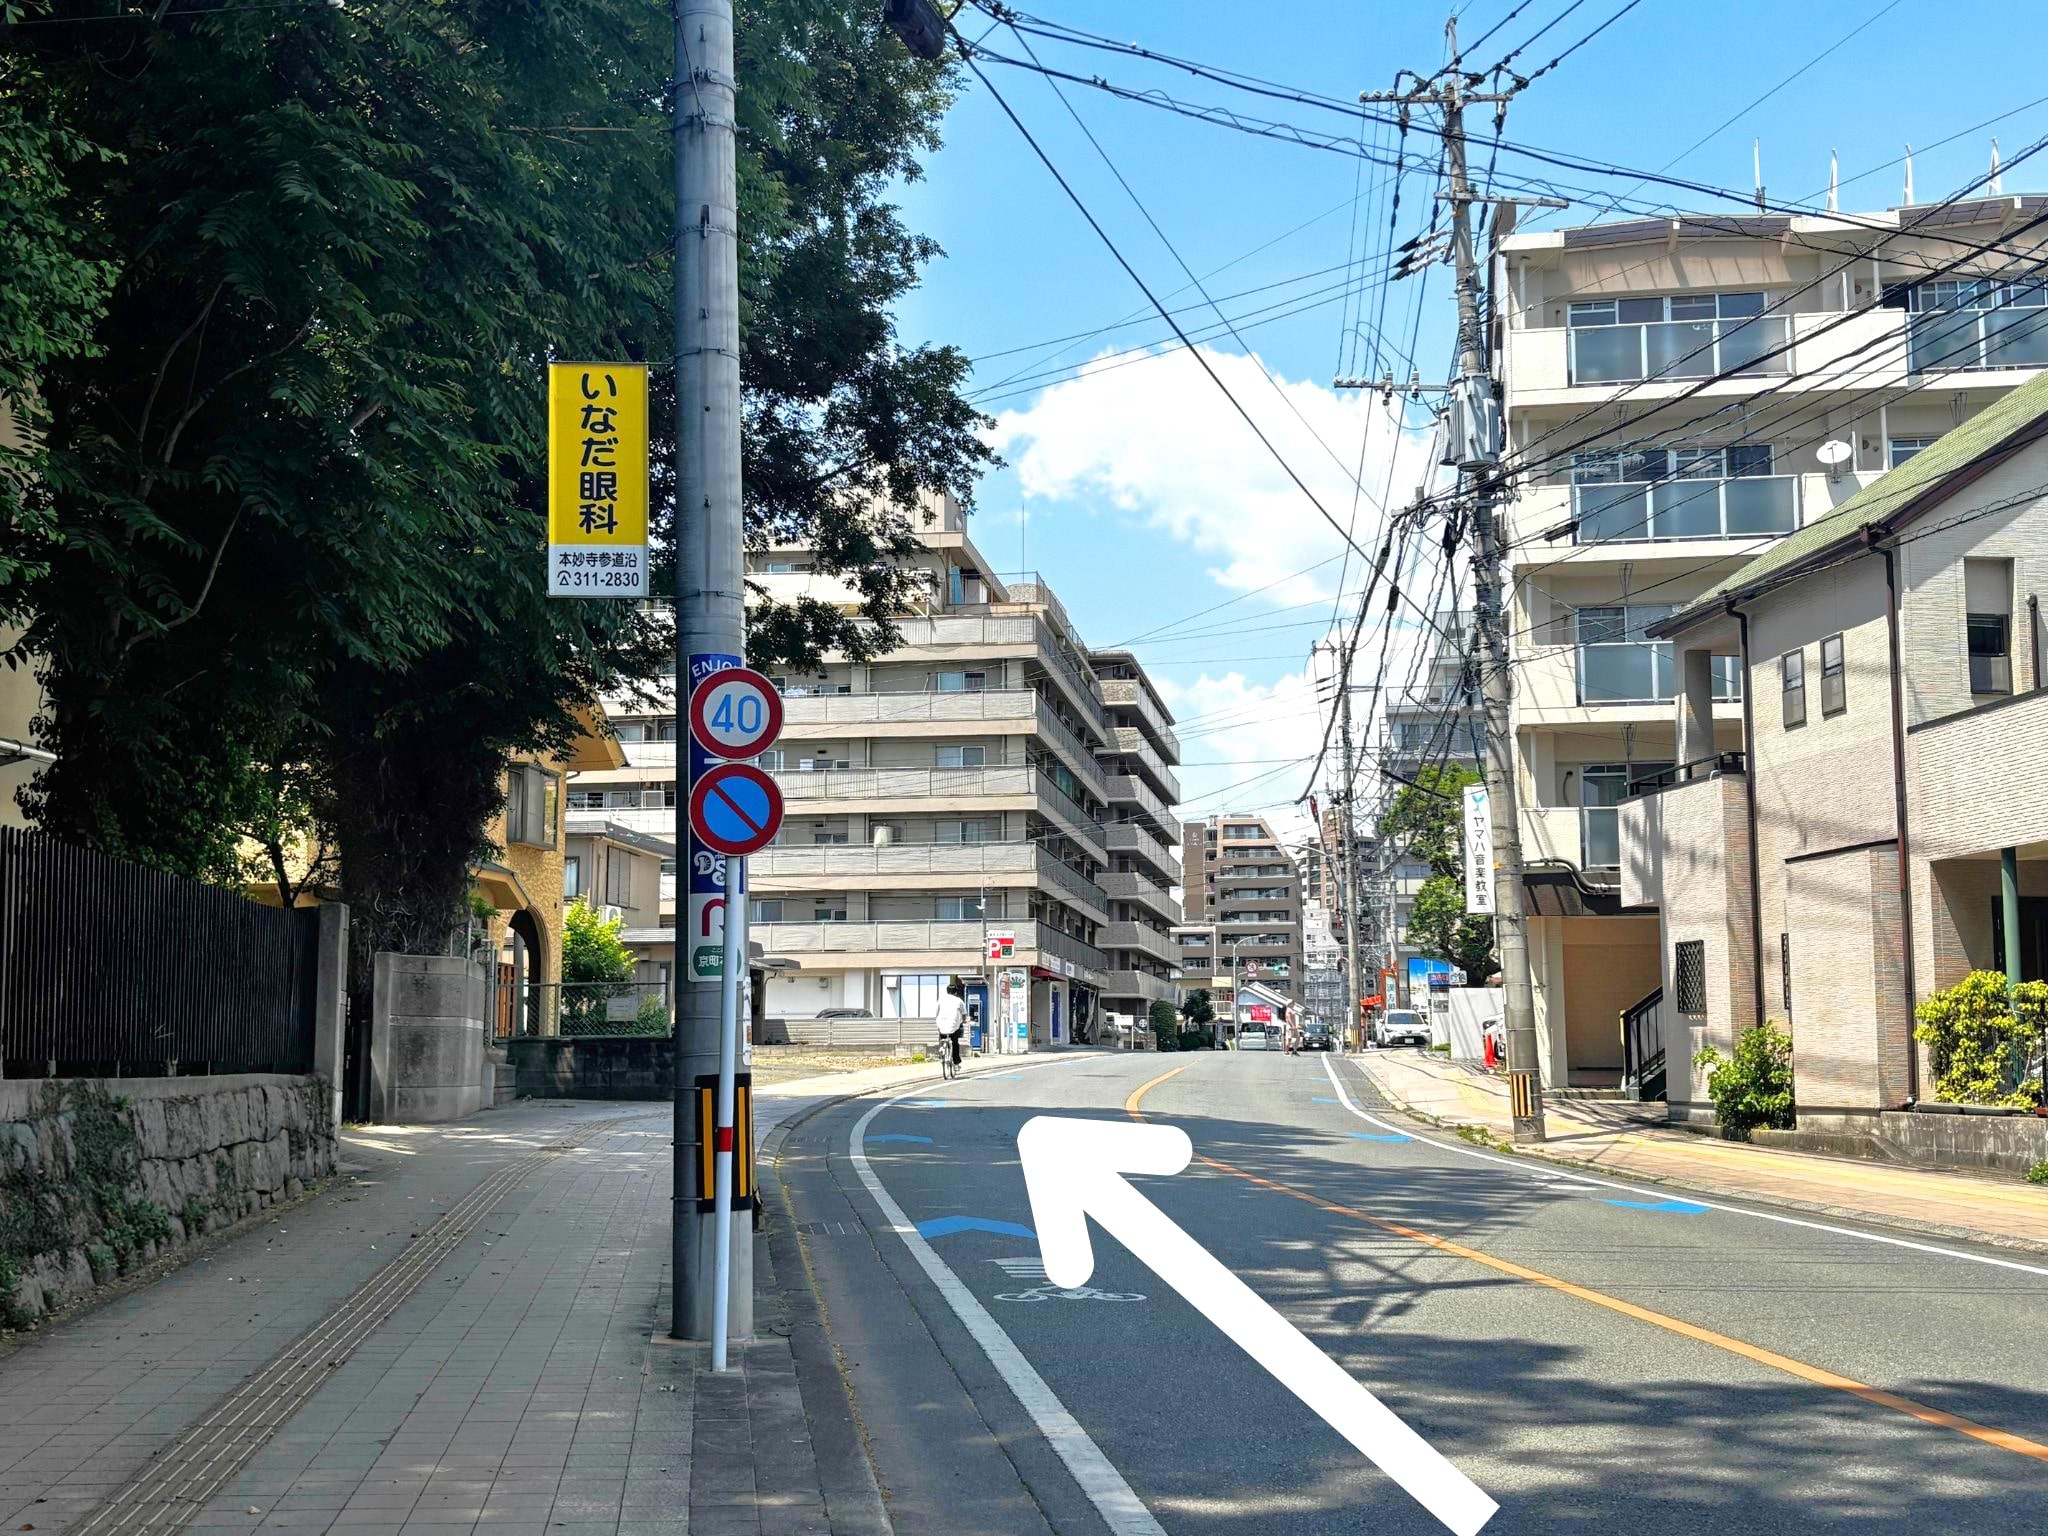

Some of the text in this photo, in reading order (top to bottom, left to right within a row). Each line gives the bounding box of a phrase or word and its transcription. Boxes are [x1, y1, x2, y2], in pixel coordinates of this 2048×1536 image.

[579, 373, 618, 535] いなだ眼科
[558, 552, 638, 568] 本妙寺参道沿
[574, 571, 639, 588] 311-2830
[691, 658, 737, 677] ENJO
[711, 694, 762, 734] 40
[1473, 816, 1488, 906] ヤマハ音楽教室
